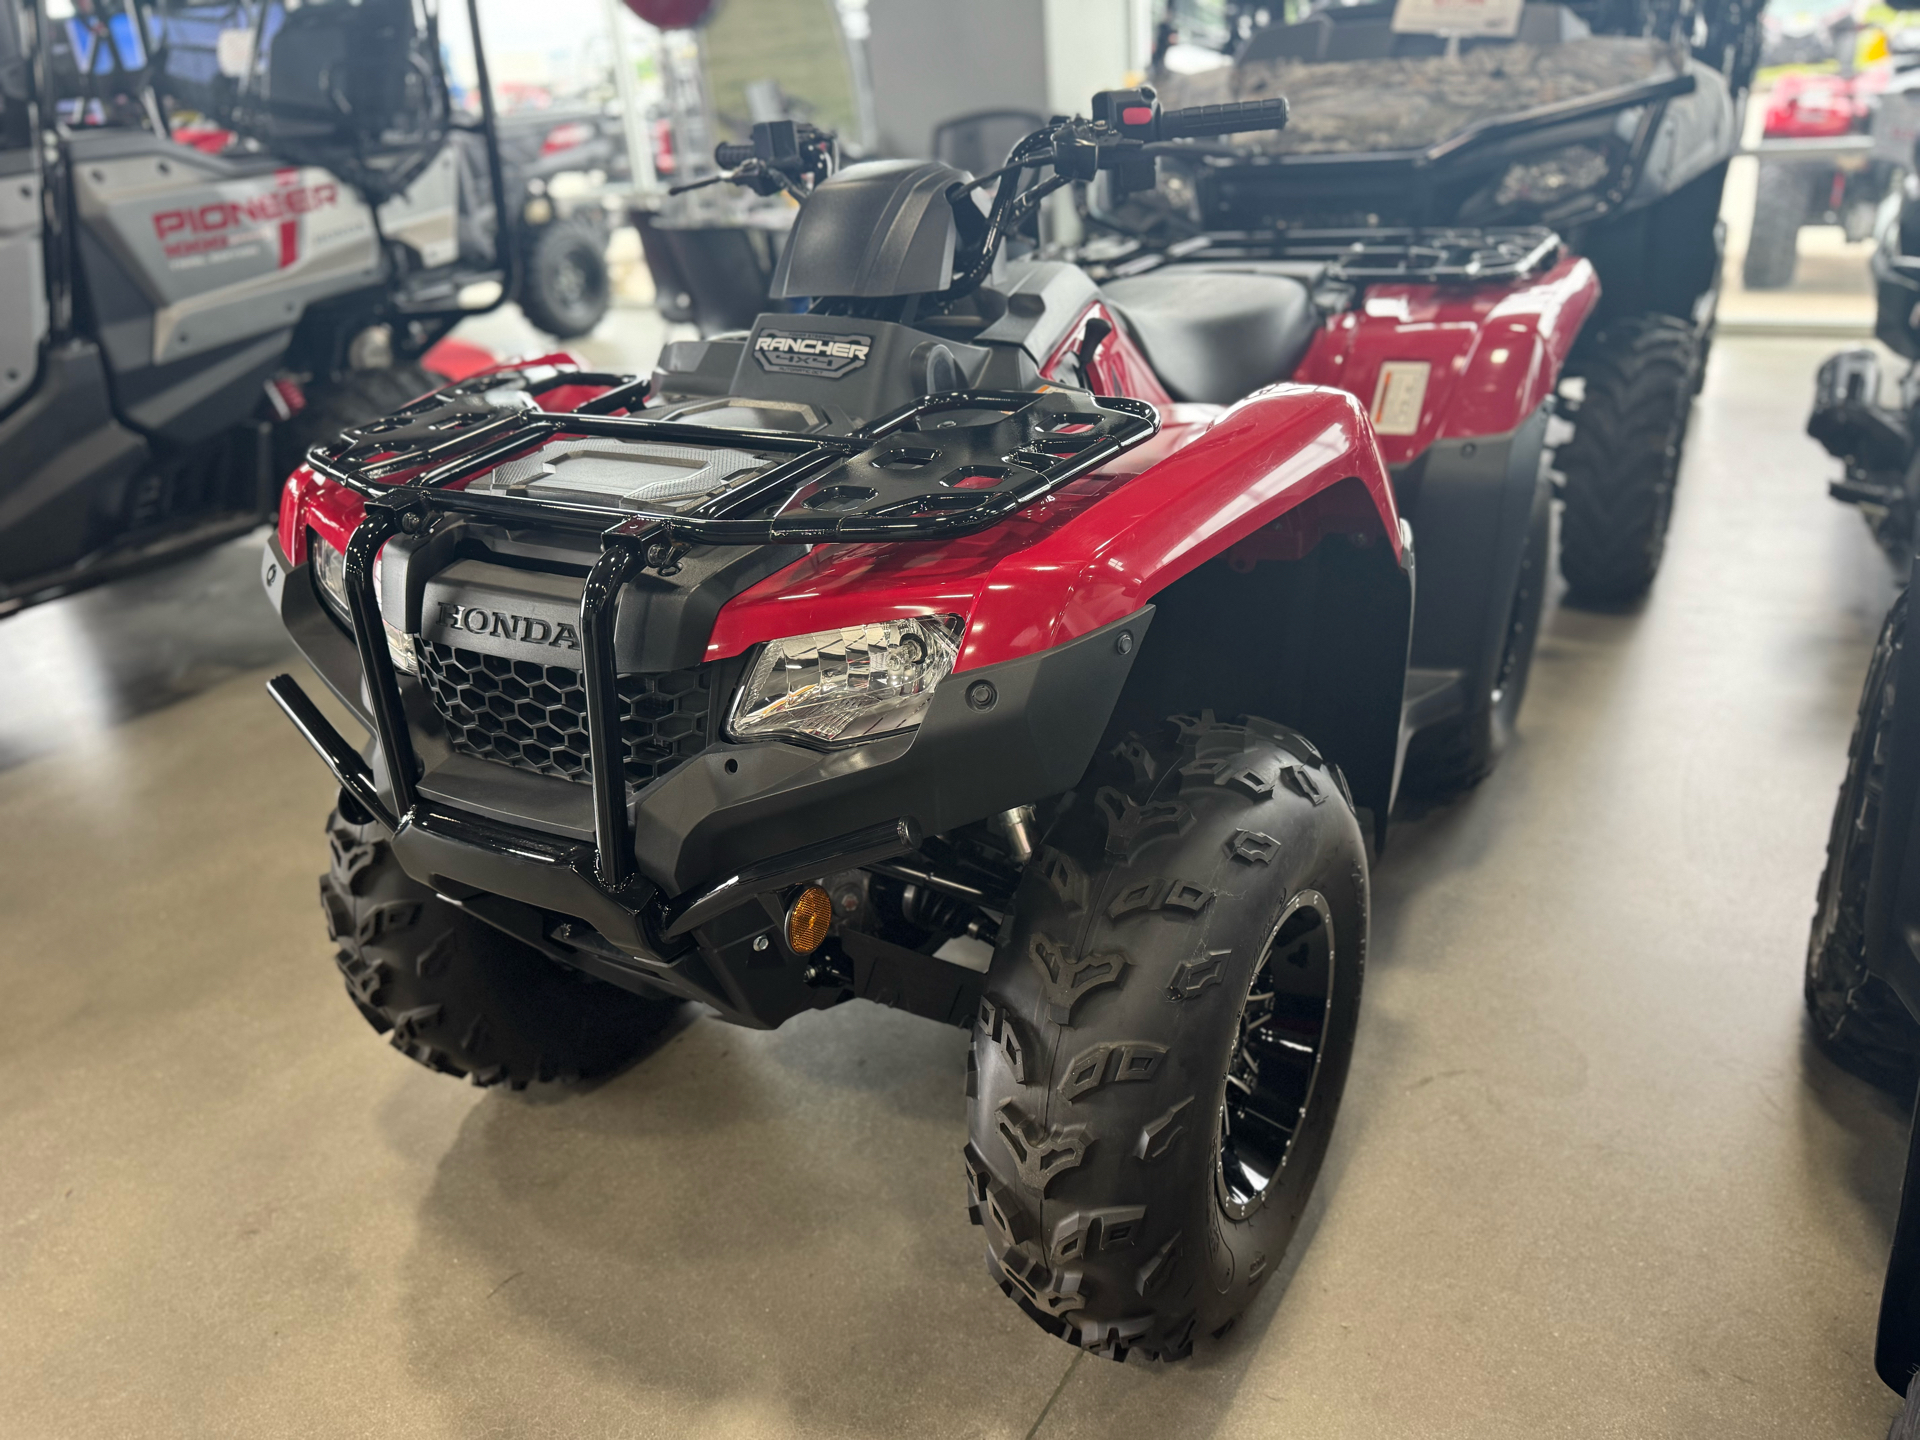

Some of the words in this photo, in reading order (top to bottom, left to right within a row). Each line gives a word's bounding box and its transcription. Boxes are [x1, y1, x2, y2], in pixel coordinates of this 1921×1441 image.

[152, 183, 338, 241] PIONEER
[755, 337, 869, 360] RANCHER
[436, 601, 581, 651] HONDA
